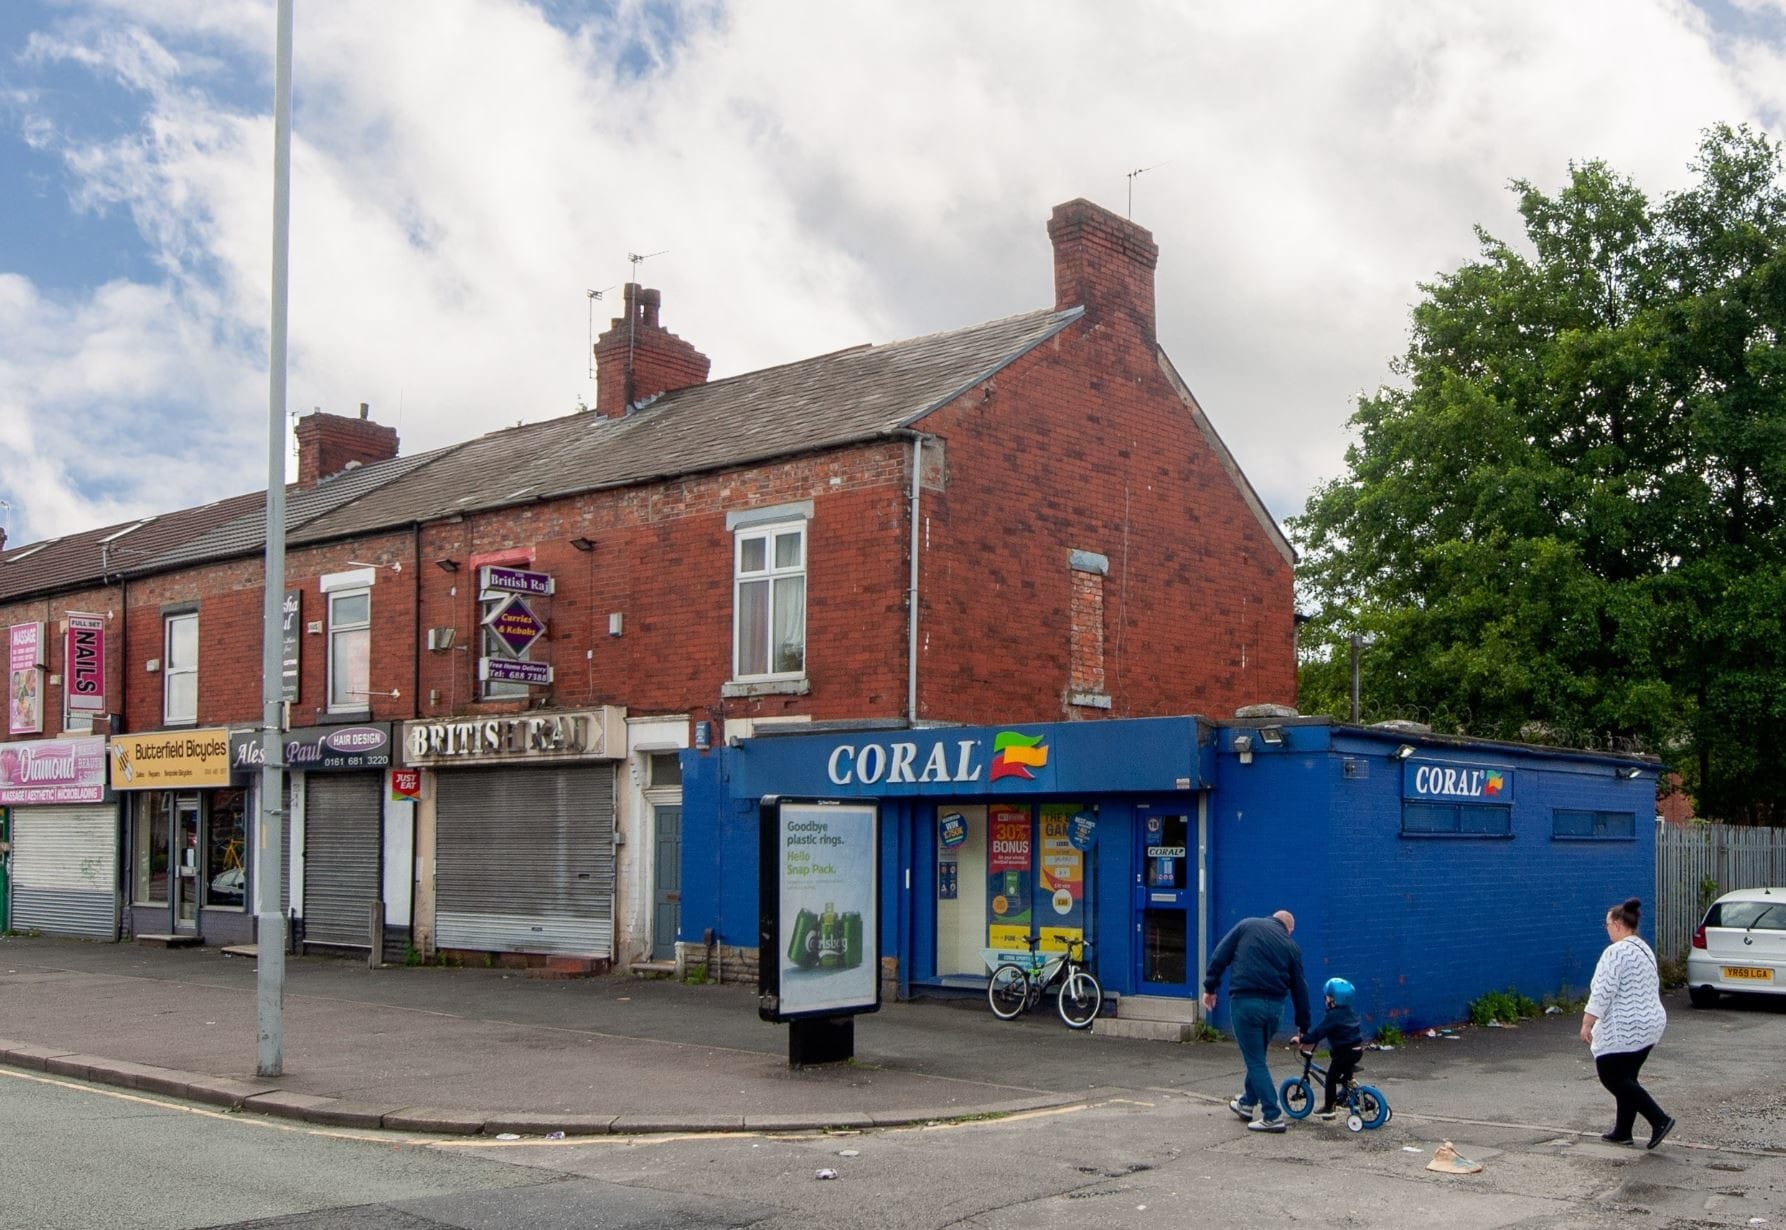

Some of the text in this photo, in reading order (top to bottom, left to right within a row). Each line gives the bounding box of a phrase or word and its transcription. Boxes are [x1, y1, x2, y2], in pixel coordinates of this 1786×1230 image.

[491, 574, 549, 593] British Raj
[501, 613, 532, 624] Curries
[506, 626, 536, 636] Kebabs
[75, 631, 97, 693] NAILS
[333, 732, 381, 746] HAIR DESIGN
[135, 738, 227, 762] Butterfield Bicycles
[286, 736, 326, 763] Paul
[19, 744, 76, 783] Diamond
[325, 755, 389, 767] 0161 681 3220
[828, 740, 982, 785] CORAL
[396, 773, 417, 782] JUST
[1415, 766, 1482, 797] CORAL
[400, 781, 417, 790] EAT
[1, 786, 98, 801] MASSAGE AESTHETIC MICROBLADING
[787, 821, 828, 834] Goodbye
[997, 823, 1026, 840] 30%
[787, 834, 845, 847] plastic rings.
[993, 841, 1029, 854] BONUS
[1149, 848, 1180, 856] CORAL
[787, 851, 810, 861] Hello
[787, 863, 837, 876] Snap Pack.
